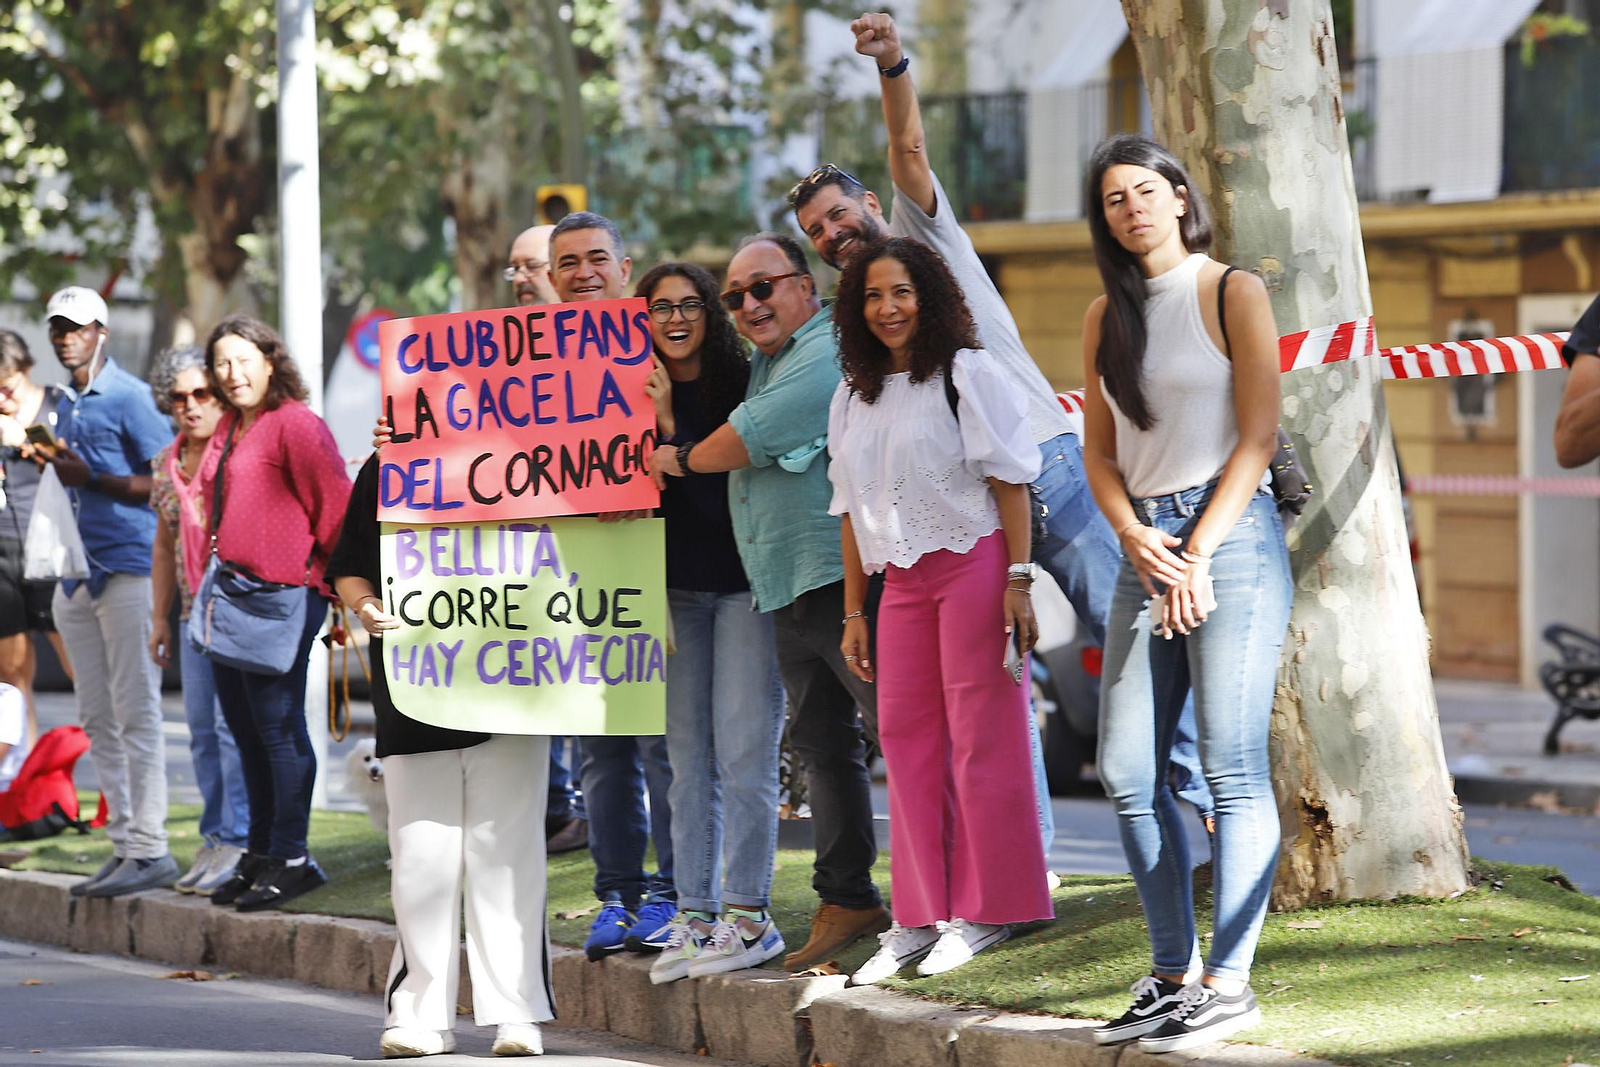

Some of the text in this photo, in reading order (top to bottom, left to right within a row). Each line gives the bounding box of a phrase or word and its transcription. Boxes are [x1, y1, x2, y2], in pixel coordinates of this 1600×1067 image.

[398, 309, 651, 375] CLUB DE FANS
[387, 369, 632, 443] LA GACELA
[380, 429, 658, 511] DEL CORNACHO
[395, 523, 579, 588] BELLITA,
[547, 588, 642, 628] QUE
[392, 633, 666, 687] HAY CERVECITA
